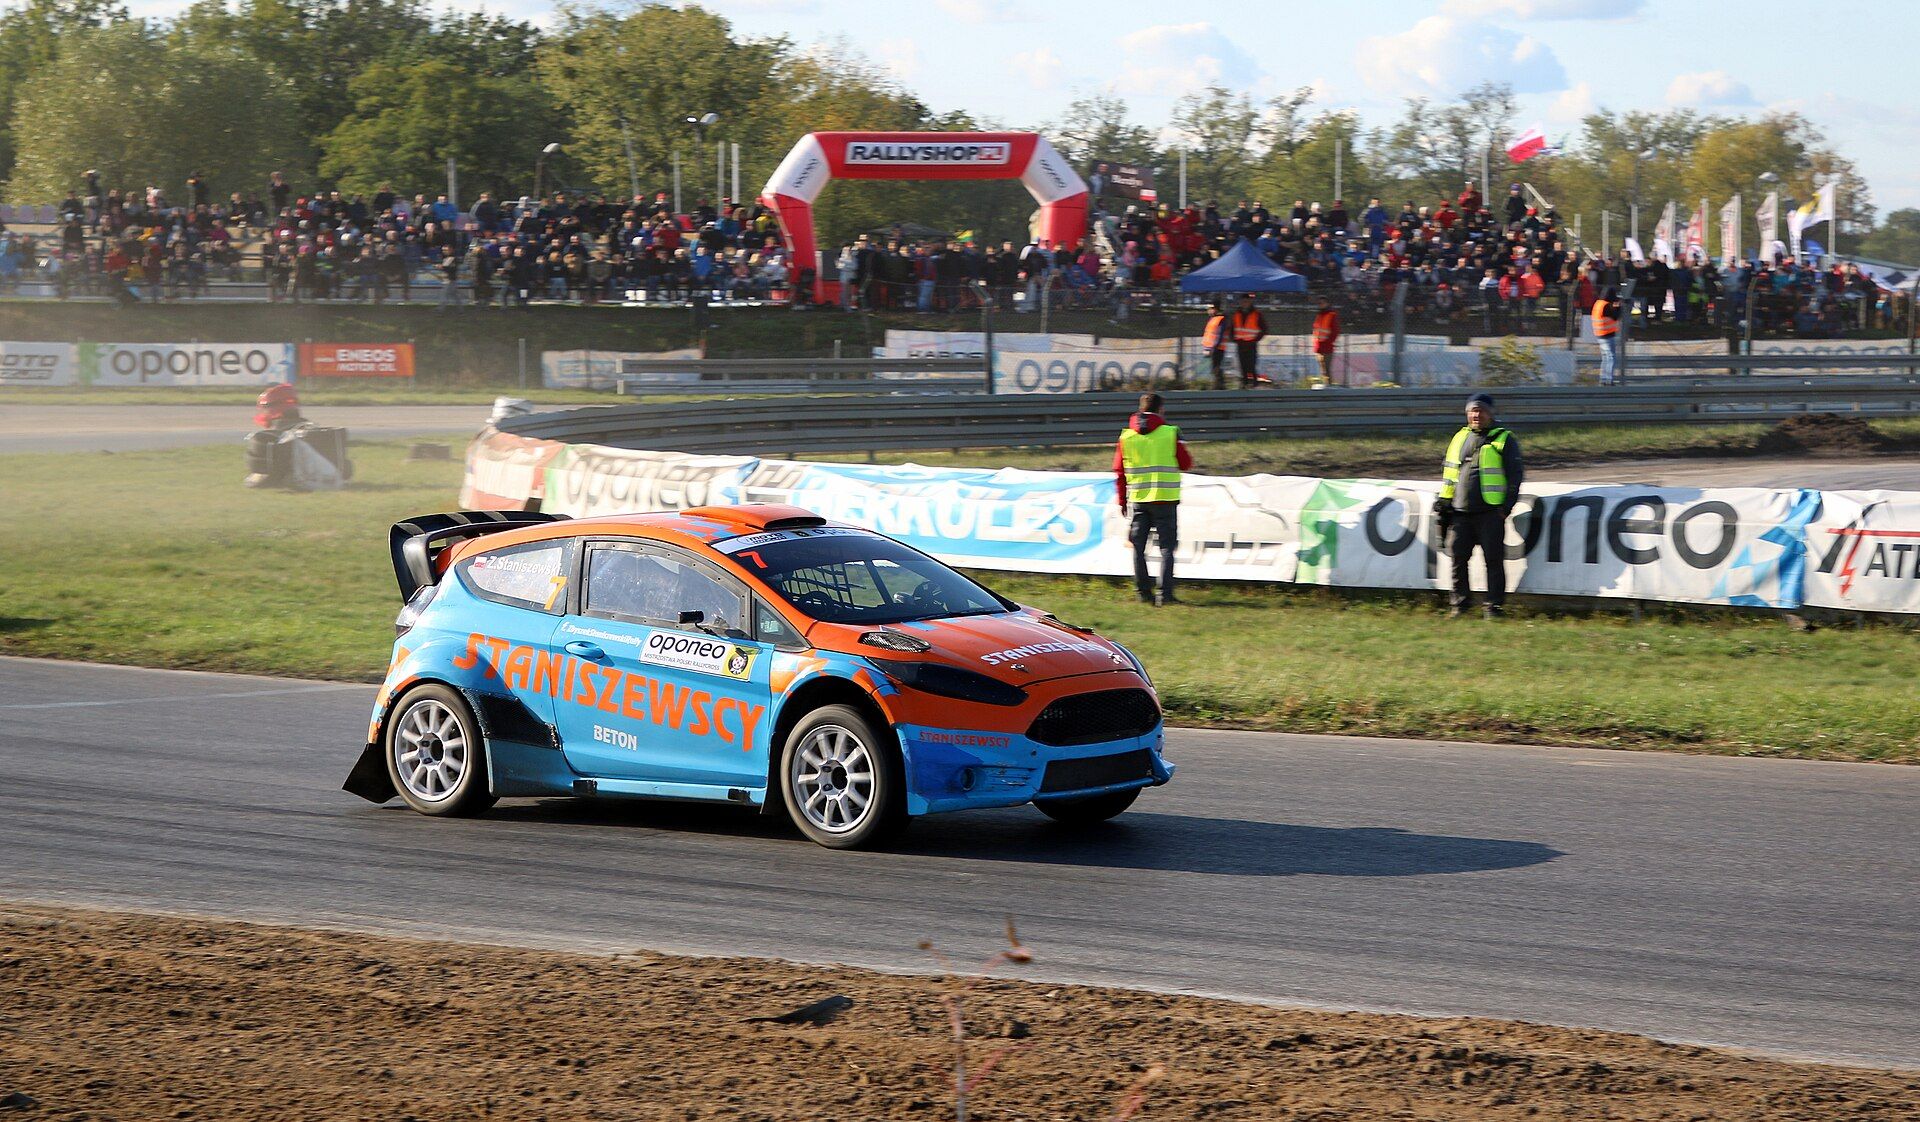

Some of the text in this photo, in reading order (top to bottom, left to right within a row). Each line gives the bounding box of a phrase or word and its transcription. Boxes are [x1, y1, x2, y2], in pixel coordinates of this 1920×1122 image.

[112, 350, 268, 382] oponeo
[336, 349, 396, 362] ENEOS
[736, 551, 768, 569] 7
[544, 575, 568, 611] 7
[649, 634, 726, 659] oponeo
[452, 633, 765, 752] STANISZEWSCY
[593, 725, 638, 751] BETON
[919, 731, 1010, 749] STANISZEWSCY
